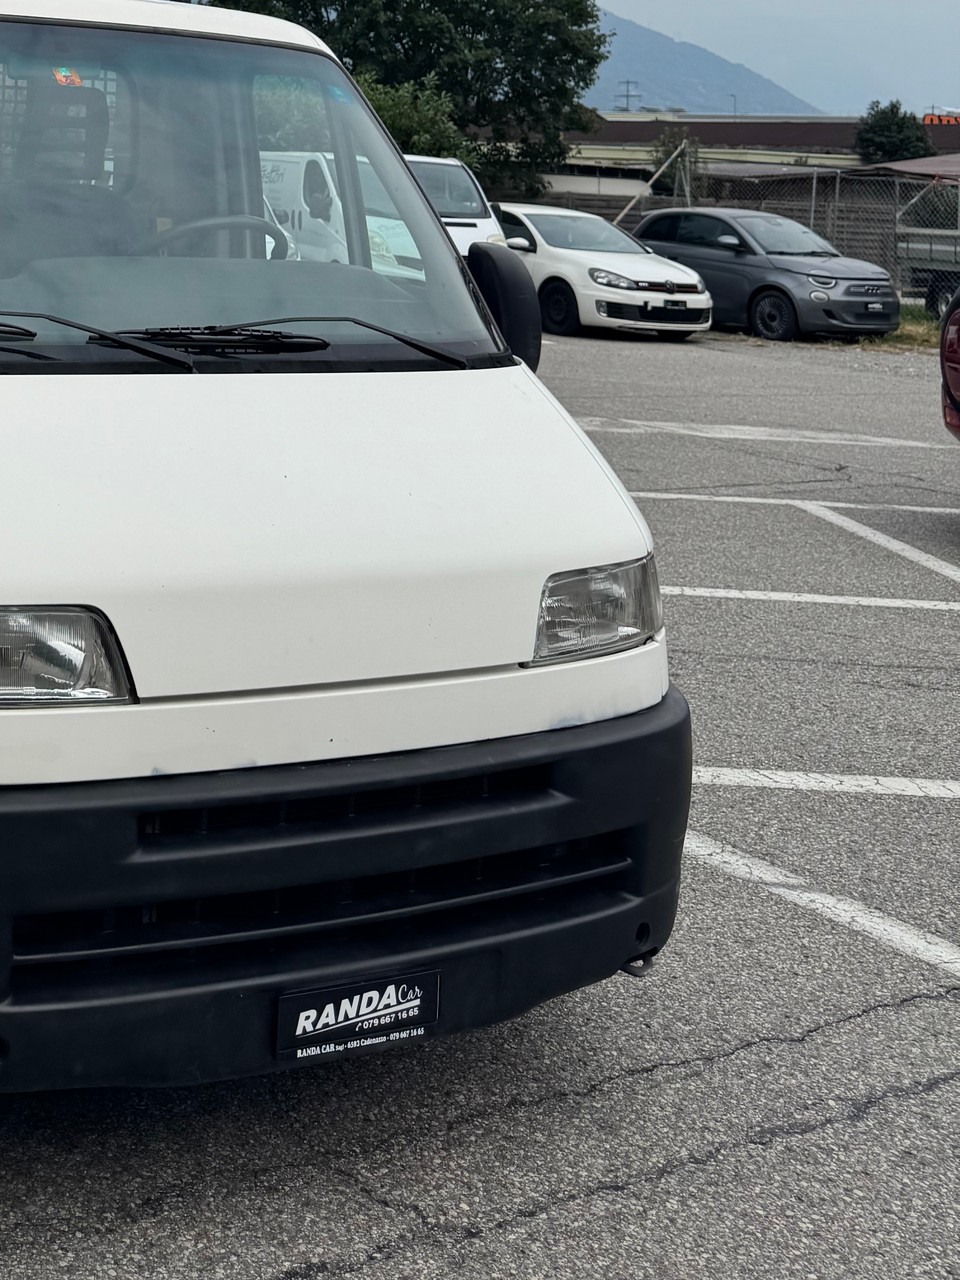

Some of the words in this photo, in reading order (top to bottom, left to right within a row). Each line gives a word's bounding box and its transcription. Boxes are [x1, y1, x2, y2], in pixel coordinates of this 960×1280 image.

[295, 984, 397, 1036] RANDA
[398, 984, 423, 1003] Car
[363, 1019, 379, 1029] 079
[380, 1014, 396, 1024] 667
[398, 1011, 408, 1020] 16
[409, 1007, 419, 1016] 65
[296, 1046, 321, 1059] RANDA
[321, 1043, 335, 1054] CAR
[390, 1032, 400, 1041] 079
[400, 1030, 410, 1039] 667
[418, 1027, 425, 1035] 65
